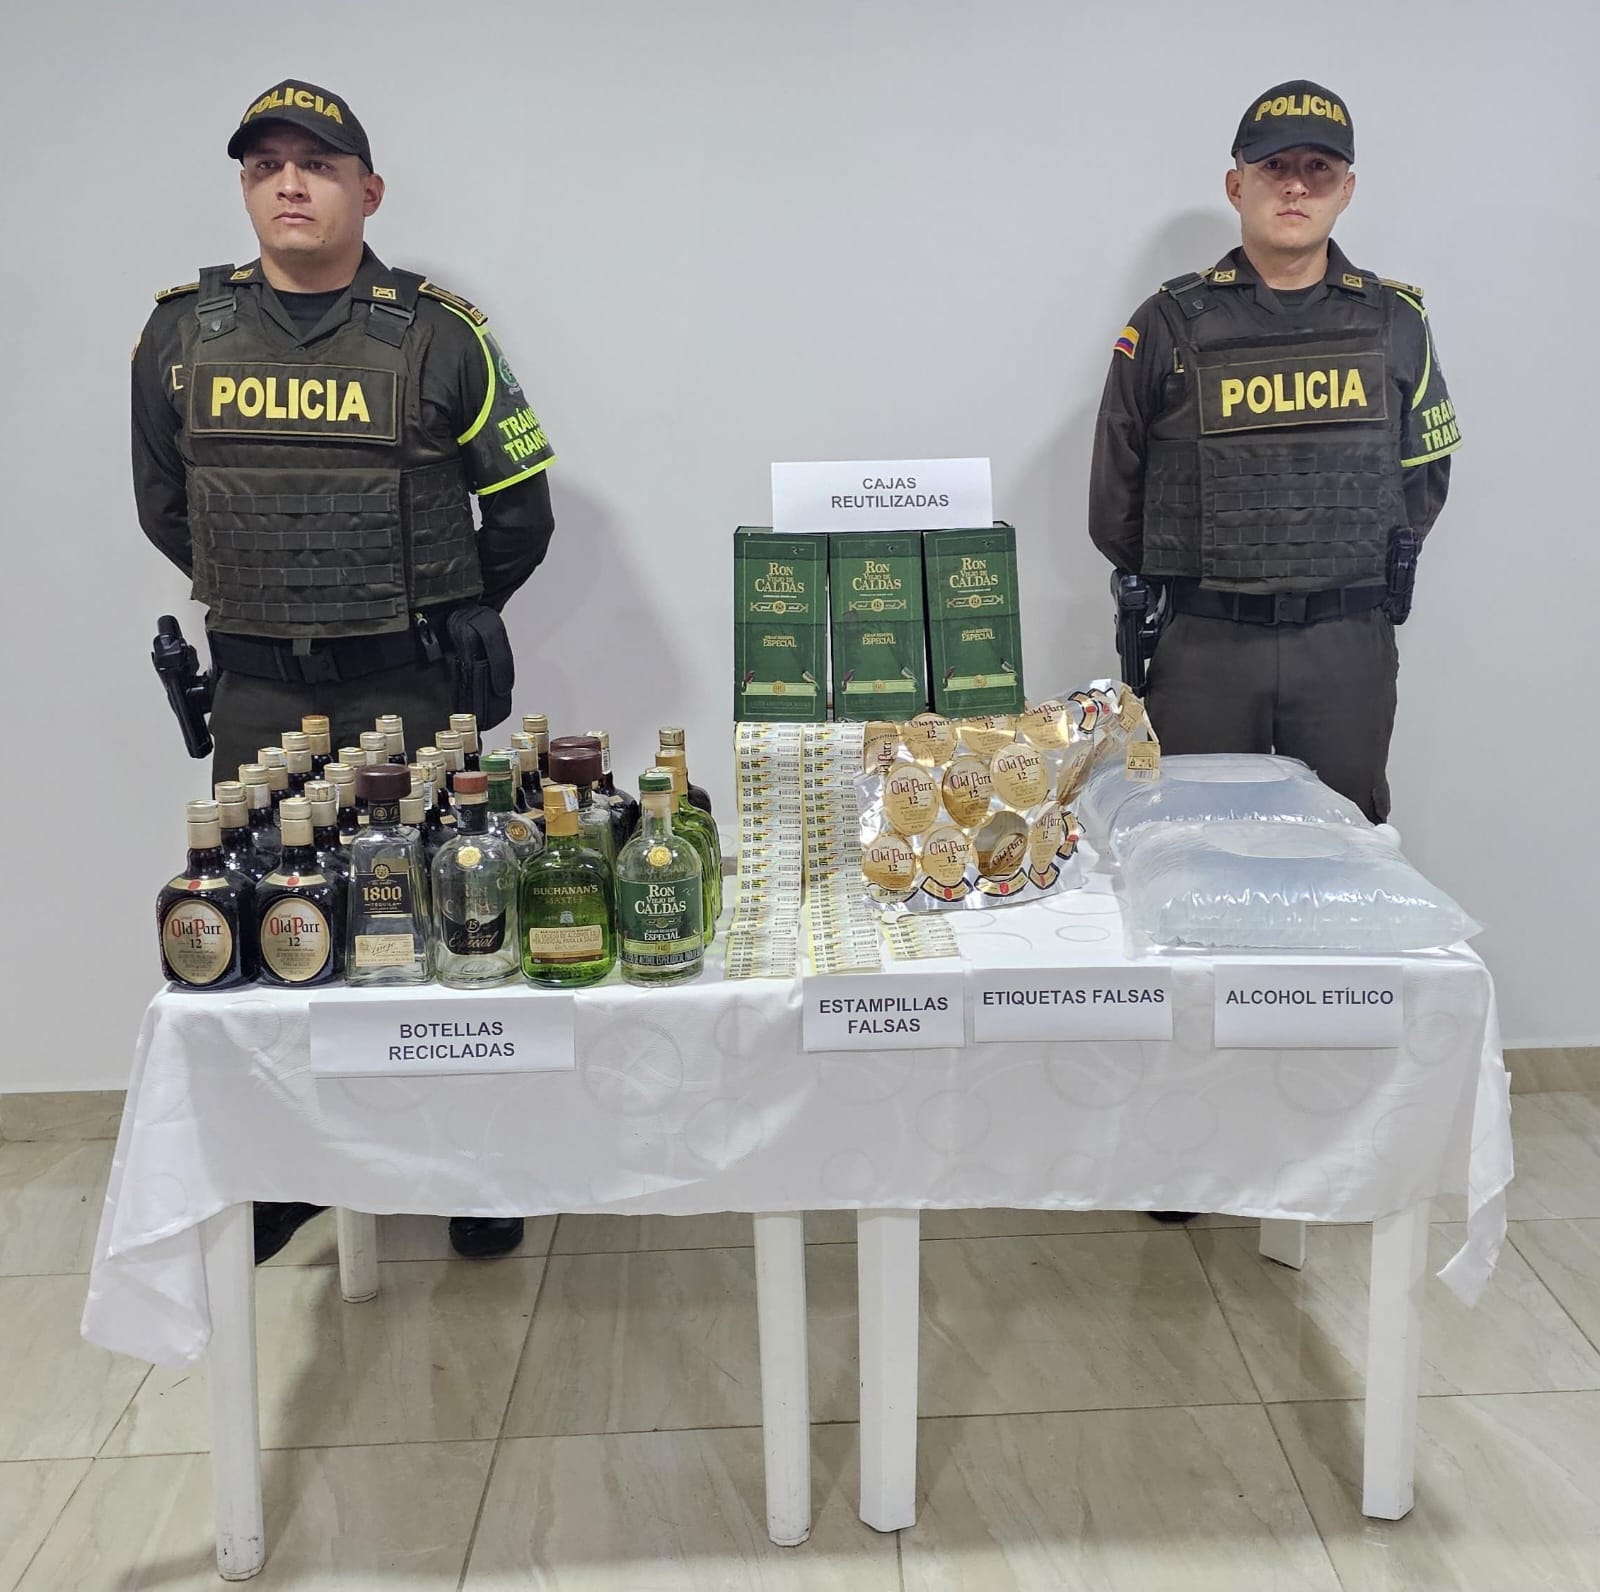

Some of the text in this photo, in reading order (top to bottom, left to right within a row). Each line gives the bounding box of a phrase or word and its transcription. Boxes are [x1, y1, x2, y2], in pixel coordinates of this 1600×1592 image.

[243, 87, 343, 125] POLICIA
[1255, 94, 1348, 126] POLICIA
[211, 376, 370, 422] POLICIA
[1221, 369, 1368, 417] POLICIA
[862, 477, 917, 490] CAJAS
[831, 494, 949, 508] REUTILIZADAS
[769, 562, 794, 576] RON
[865, 561, 890, 573] RON
[961, 557, 987, 570] RON
[754, 578, 805, 593] CALDAS
[852, 577, 901, 591] CALDAS
[949, 575, 998, 588] CALDAS
[927, 730, 937, 738] 12
[998, 755, 1040, 773] Old Parr
[950, 771, 991, 790] Old Parr
[1017, 772, 1028, 781] 12
[891, 778, 933, 795] Old Parr
[908, 796, 919, 805] 12
[969, 790, 979, 798] 12
[929, 840, 969, 855] Old Parr
[871, 848, 913, 864] Old Parr
[947, 855, 957, 863] 12
[888, 864, 898, 872] 12
[362, 886, 402, 901] 1800
[533, 884, 599, 896] BUCHANAN'S
[648, 884, 675, 897] RON
[634, 900, 687, 914] CALDAS
[171, 918, 222, 938] Old Parr
[270, 917, 320, 936] Old Parr
[289, 937, 300, 947] 12
[644, 931, 680, 940] ESPECIAL
[190, 939, 202, 949] 12
[983, 989, 1165, 1006] ETIQUETAS FALSAS
[1226, 987, 1394, 1005] ALCOHOL ETÍLICO
[819, 997, 949, 1013] ESTAMPILLAS
[400, 1021, 503, 1039] BOTELLAS
[848, 1018, 921, 1034] FALSAS
[389, 1043, 515, 1061] RECICLADAS
